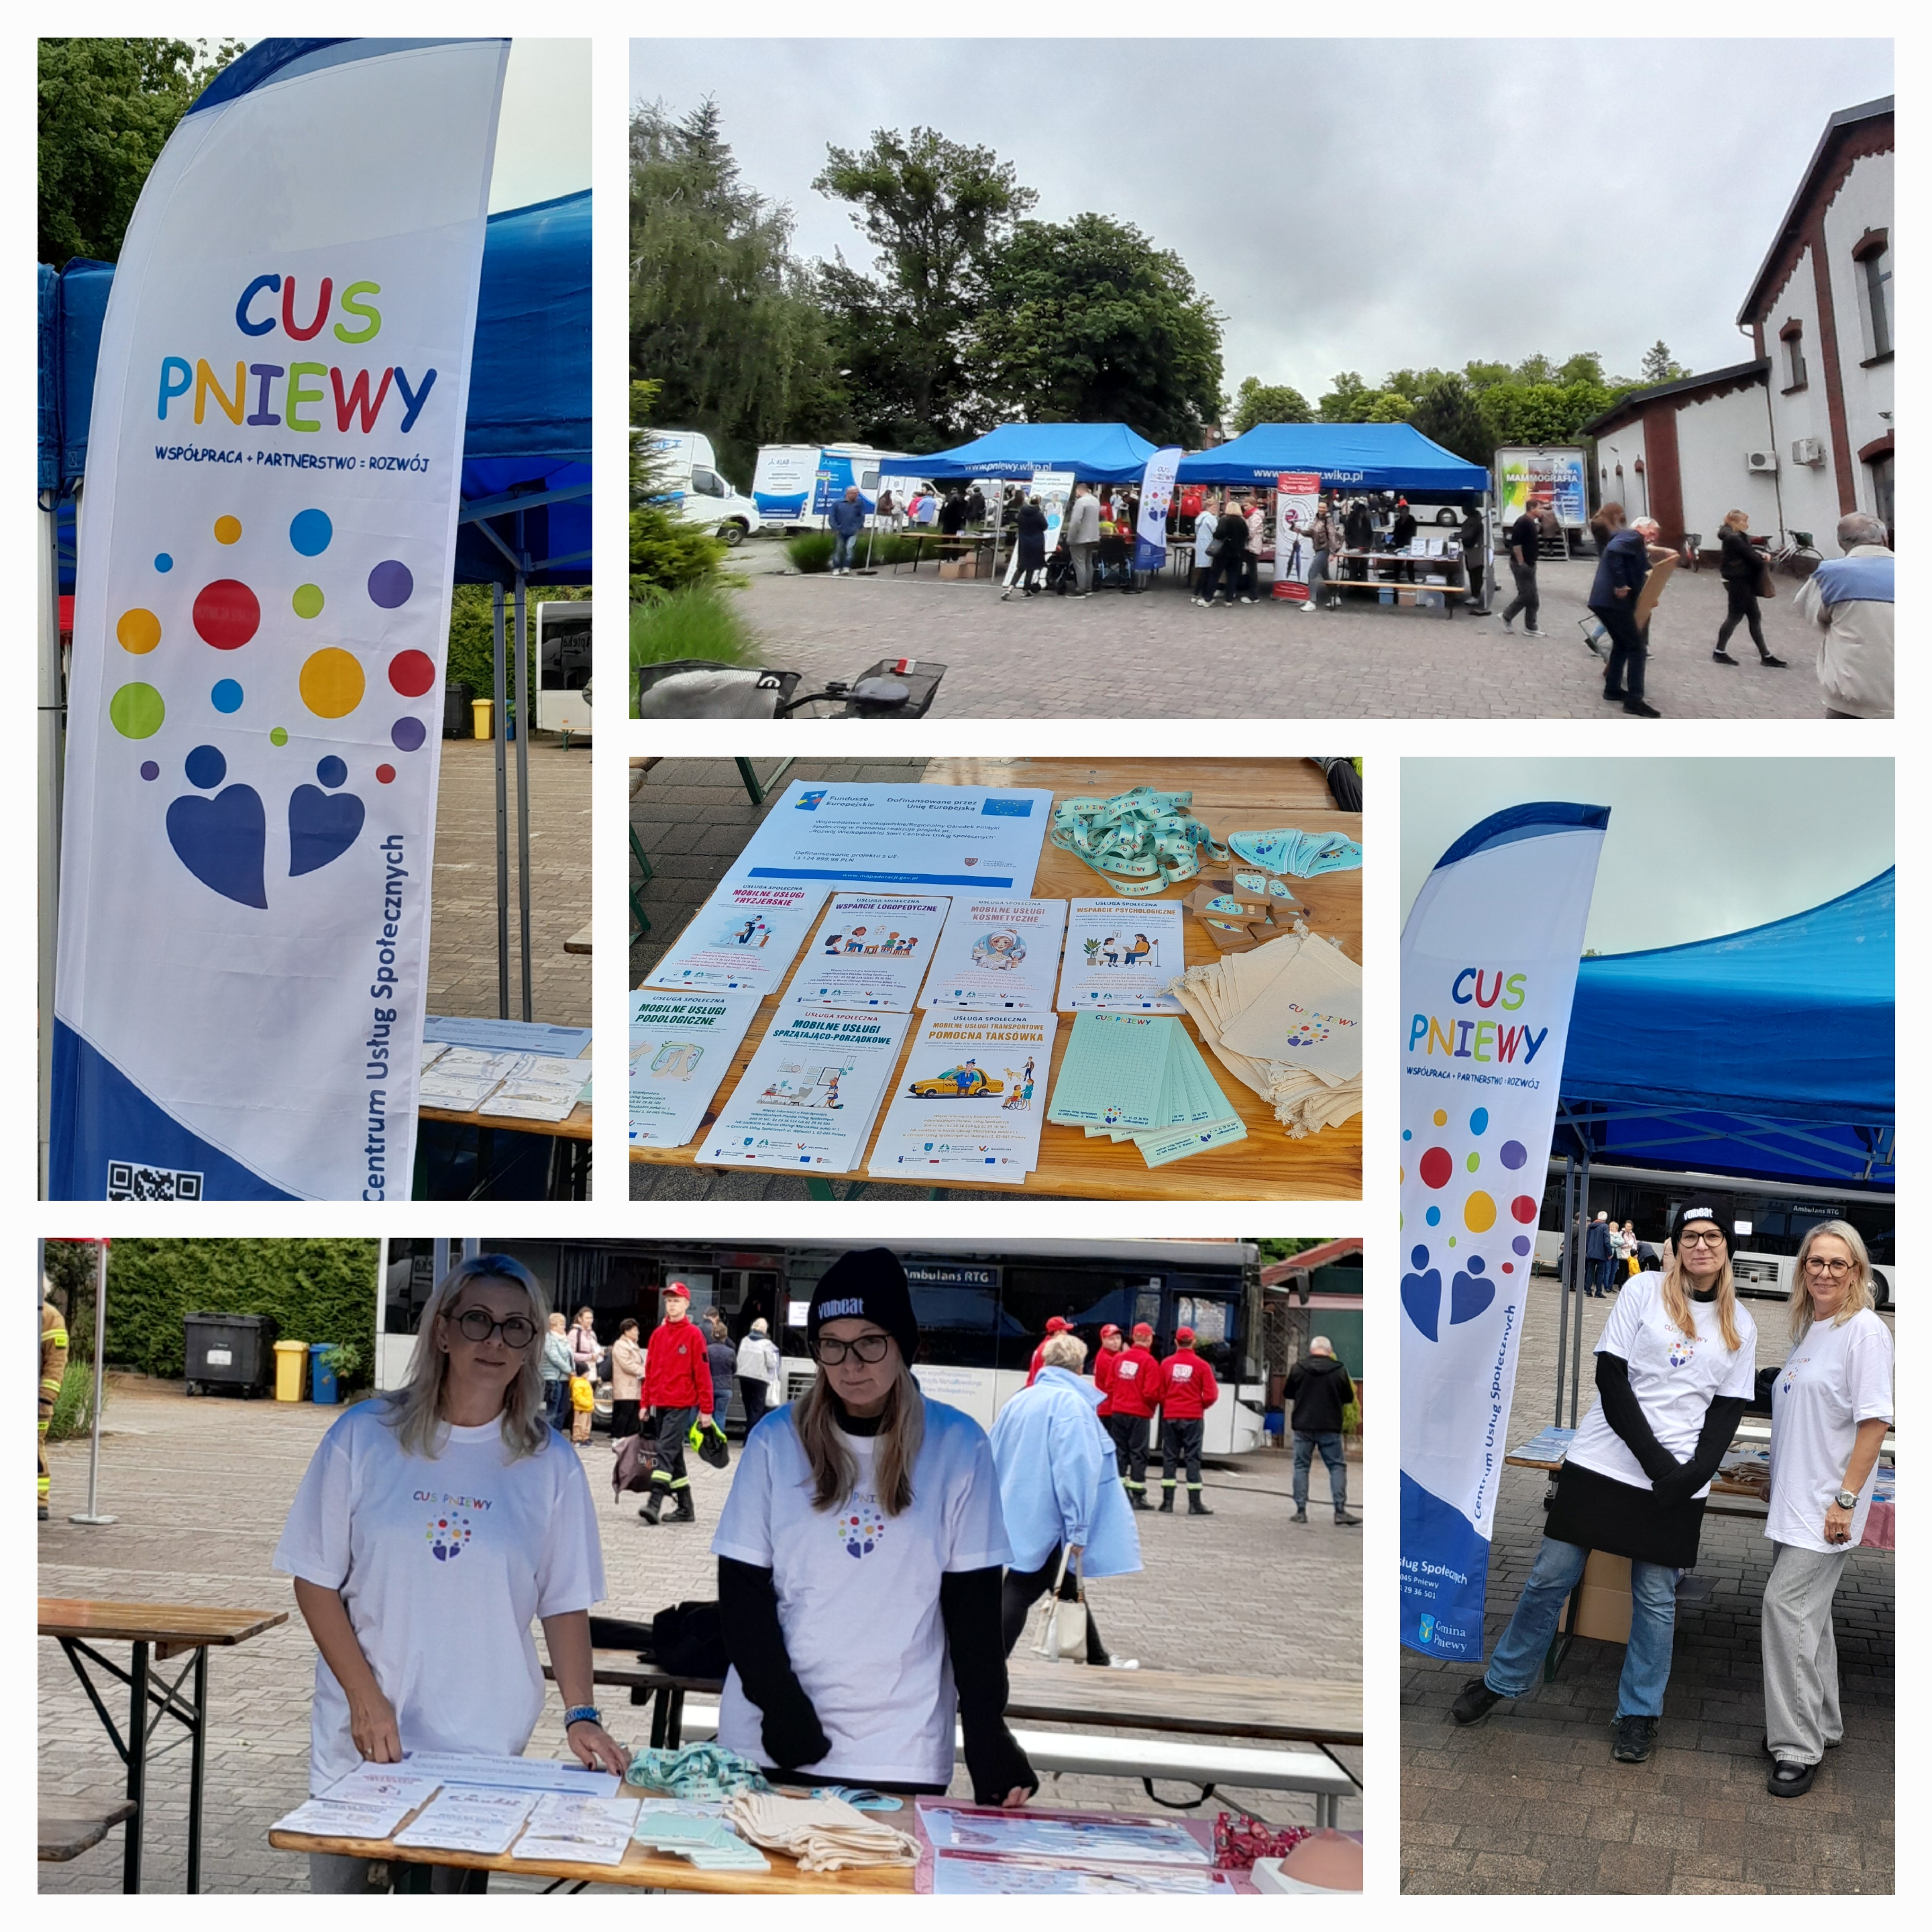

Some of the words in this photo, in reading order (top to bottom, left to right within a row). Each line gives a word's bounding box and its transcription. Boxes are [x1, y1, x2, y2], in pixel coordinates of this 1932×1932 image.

[235, 274, 381, 344] CUS
[158, 357, 437, 433] PNIEWY
[156, 443, 243, 464] WSPÓŁPRACA
[257, 451, 356, 470] PARTNERSTWO
[369, 453, 429, 472] ROZWÓJ
[965, 462, 1052, 472] www.pniewy.wlkp.pl
[1507, 474, 1578, 482] MAMMOGRAFIA
[1109, 808, 1118, 816] CUS
[1118, 800, 1139, 809] PNIEWY
[843, 873, 918, 881] www.mapadotacji.gov.pl
[733, 890, 772, 898] MOBILNE
[734, 897, 793, 906] FRYZJERSKIE
[877, 904, 938, 912] LOGOPEDYCZNE
[971, 906, 1010, 914] MOBILNE
[372, 835, 409, 999] Społecznych
[973, 914, 1038, 922] KOSMETYCZNE
[1452, 968, 1527, 1010] CUS
[639, 1004, 687, 1013] MOBILNE
[688, 1006, 727, 1015] USŁUGI
[1289, 1004, 1309, 1016] CUS
[1312, 1012, 1357, 1028] PNIEWY
[635, 1014, 716, 1026] PODOLOGICZNE
[792, 1020, 840, 1031] MOBILNE
[842, 1023, 881, 1034] USŁUGI
[1116, 1016, 1151, 1025] PNIEWY
[367, 1007, 396, 1080] Usług
[773, 1030, 892, 1045] SPRZĄTAJĄCO-PORZĄDKOWE
[928, 1031, 982, 1040] POMOCNA
[986, 1031, 1043, 1042] TAKSÓWKA
[1409, 1014, 1548, 1065] PNIEWY
[1407, 1065, 1450, 1079] WSPÓŁPRACA
[1457, 1073, 1503, 1085] PARTNERSTWO
[1507, 1077, 1540, 1089] ROZWÓJ
[363, 1089, 386, 1201] Centrum
[1793, 1205, 1825, 1214] Ambulans
[965, 1271, 989, 1283] RTG
[1665, 1324, 1678, 1333] CUS
[1491, 1305, 1515, 1400] Społecznych
[1485, 1405, 1501, 1447] Usług
[1474, 1453, 1492, 1519] Centrum
[413, 1491, 437, 1502] CUS
[443, 1493, 492, 1510] PNIEWY
[1421, 1561, 1468, 1585] Społecznych
[1413, 1576, 1439, 1589] Pniewy
[1404, 1586, 1412, 1594] 29
[1424, 1591, 1436, 1599] 501
[1436, 1621, 1466, 1637] Gmina
[1434, 1634, 1467, 1653] Pniewy
